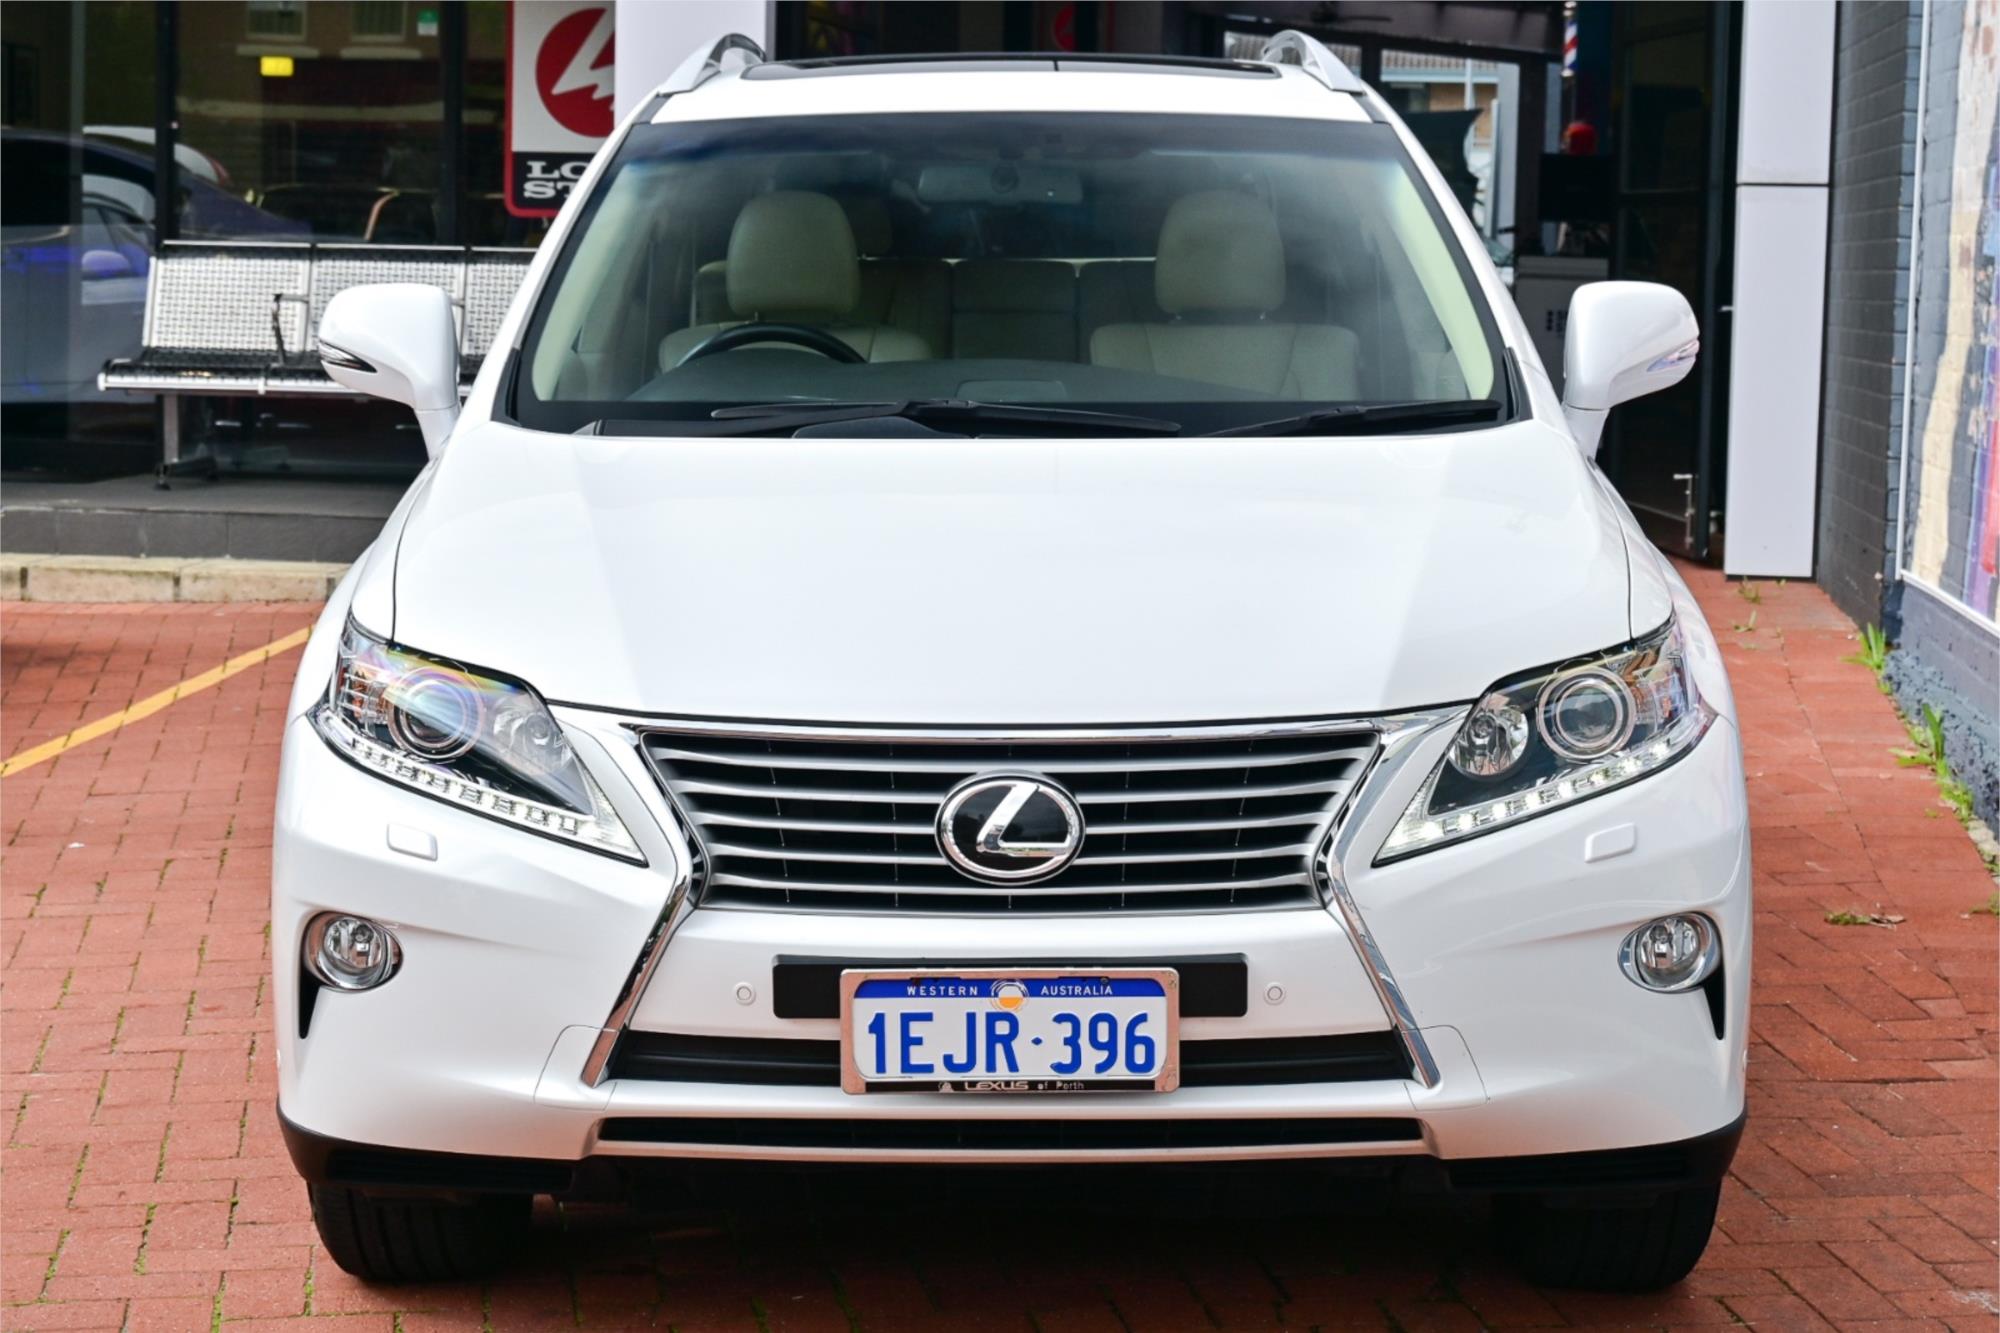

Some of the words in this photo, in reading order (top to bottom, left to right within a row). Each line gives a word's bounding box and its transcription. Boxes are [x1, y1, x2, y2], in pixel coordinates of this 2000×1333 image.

[907, 986, 978, 996] WESTERN
[1040, 985, 1113, 996] AUSTRALIA
[964, 1081, 1029, 1091] LEXUS
[1037, 1081, 1048, 1090] of
